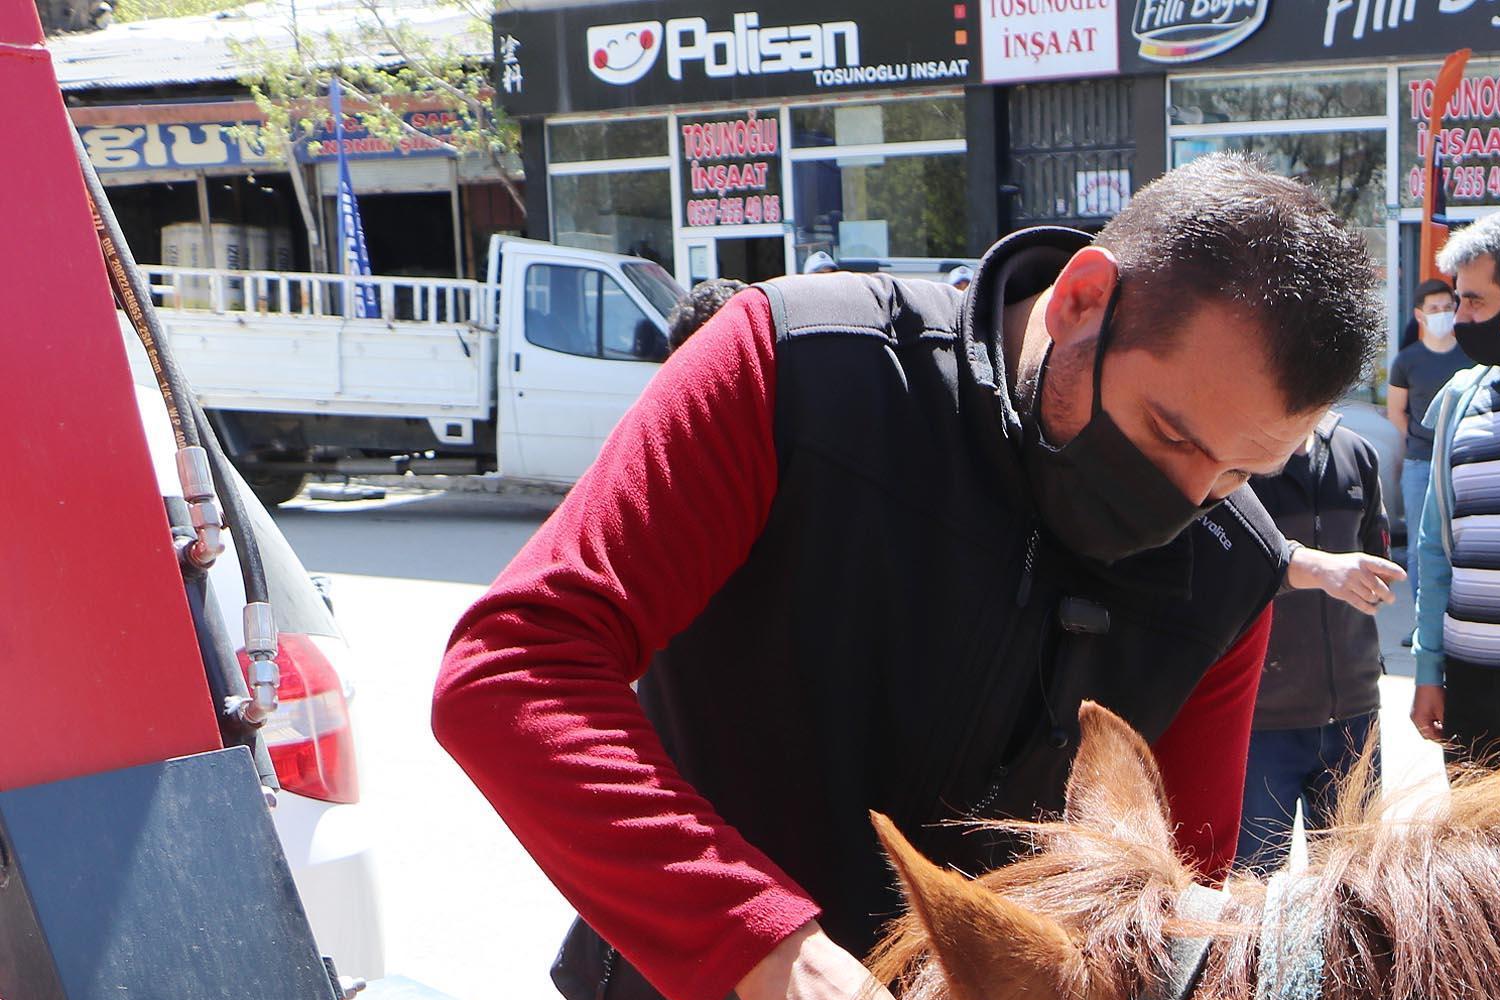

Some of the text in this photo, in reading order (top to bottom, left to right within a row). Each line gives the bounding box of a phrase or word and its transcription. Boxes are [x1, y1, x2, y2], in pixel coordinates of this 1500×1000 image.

[666, 11, 861, 81] Polisan
[1003, 27, 1098, 63] İNŞAAT
[813, 63, 908, 87] TOSUNOGLU
[682, 109, 778, 160] TOSUNOĞLU
[691, 160, 768, 196] İNŞAAT
[744, 195, 762, 223] 40
[763, 194, 781, 223] 85
[1198, 516, 1233, 551] volite
